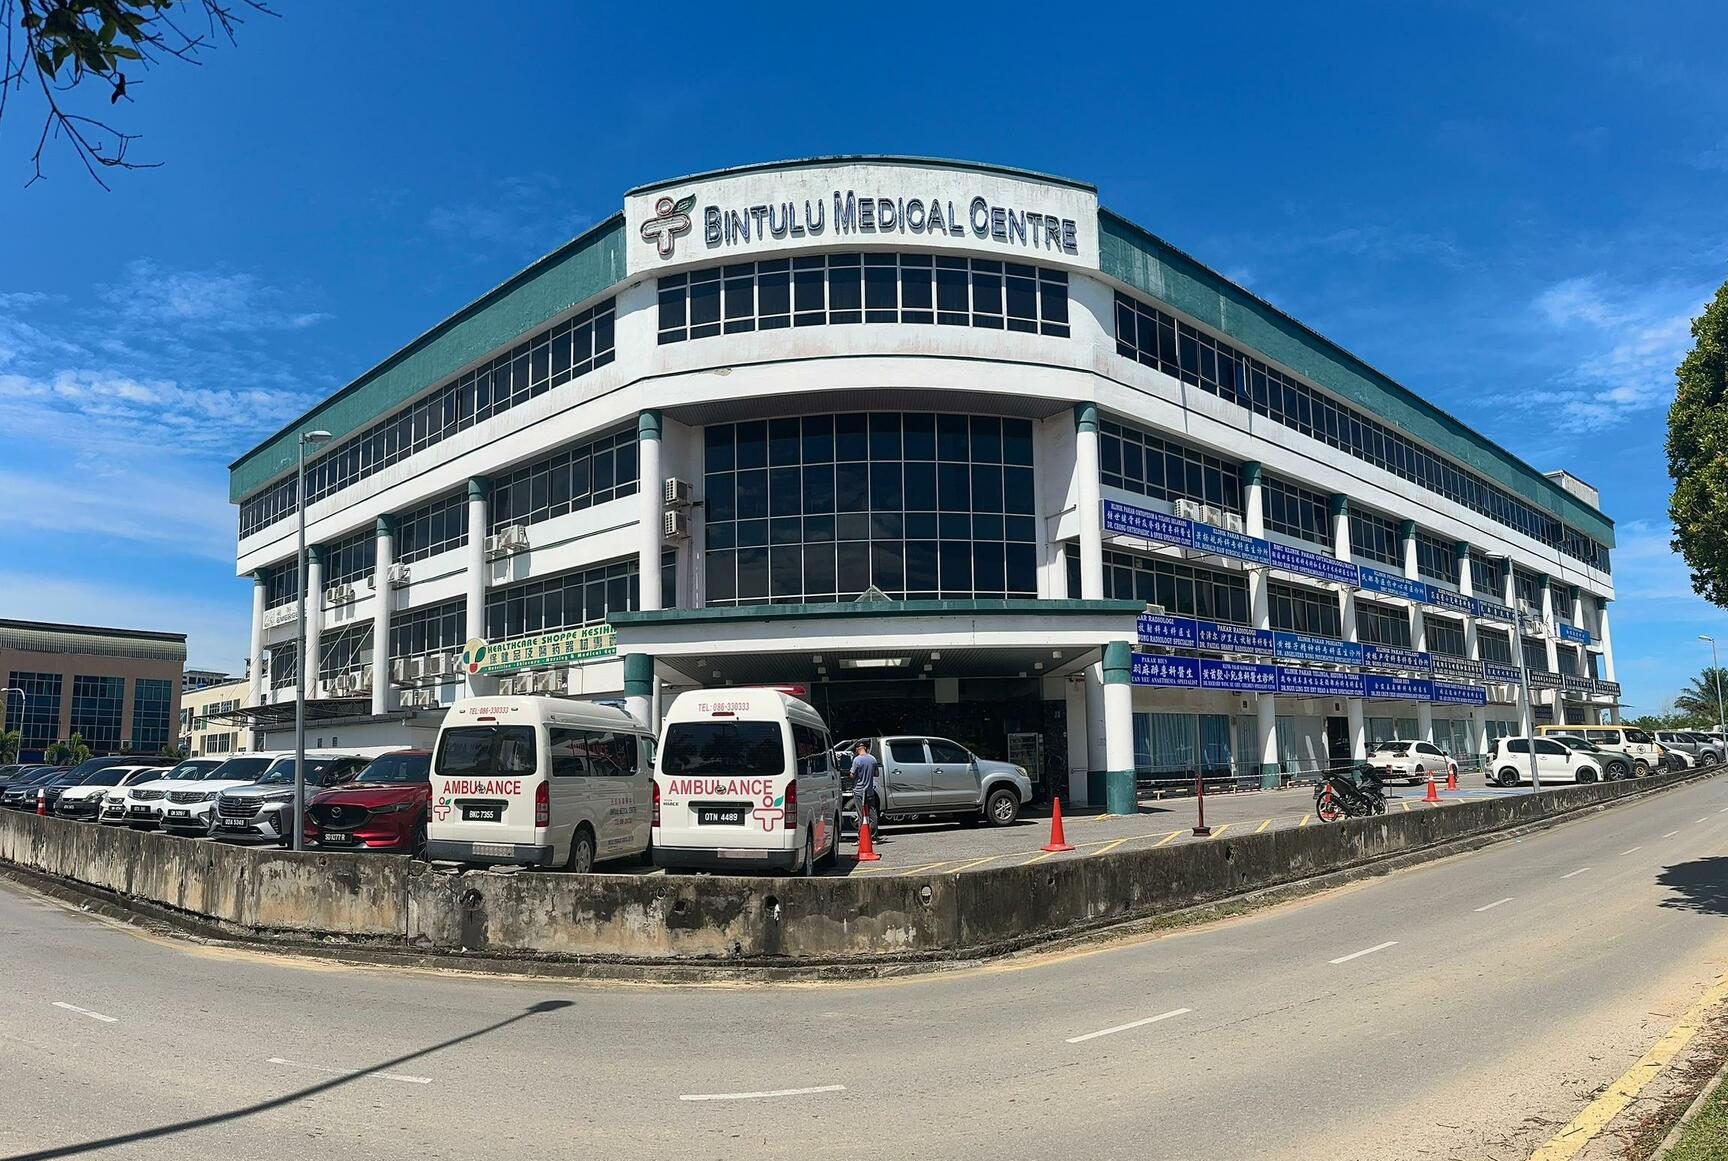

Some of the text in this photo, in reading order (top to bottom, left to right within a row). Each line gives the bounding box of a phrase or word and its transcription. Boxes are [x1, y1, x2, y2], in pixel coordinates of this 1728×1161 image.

[705, 190, 1078, 250] BINTULU MEDICAL CENTRE
[1148, 615, 1173, 624] RADIOLOGI
[1233, 626, 1256, 635] RADIOLOGI
[488, 639, 538, 654] HEALTHCARE
[542, 631, 577, 644] SHOPPE
[1150, 635, 1172, 644] RADIOLOGY
[1173, 637, 1193, 646] SPECIALIST
[578, 650, 602, 658] Medical
